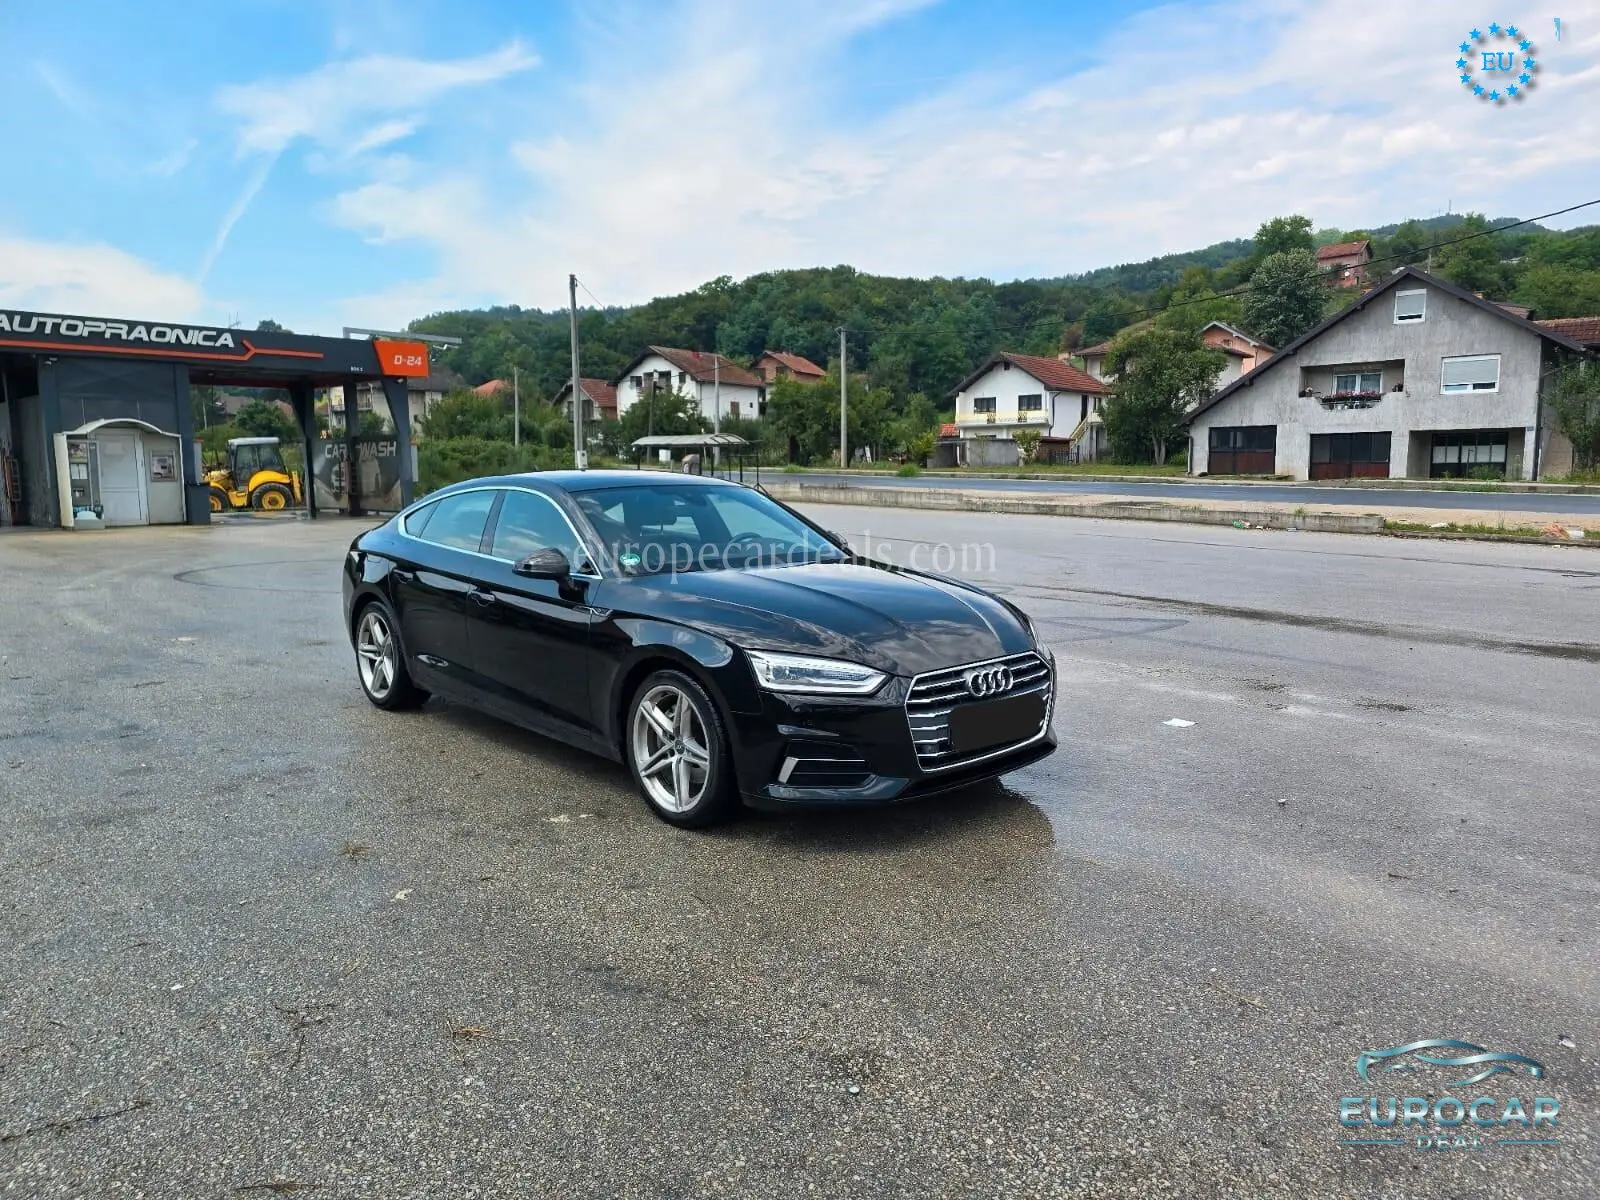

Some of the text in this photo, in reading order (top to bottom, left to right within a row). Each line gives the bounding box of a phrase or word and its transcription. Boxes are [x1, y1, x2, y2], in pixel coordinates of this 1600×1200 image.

[0, 313, 234, 348] AUTOPRAONICA
[324, 441, 396, 458] CAR WASH
